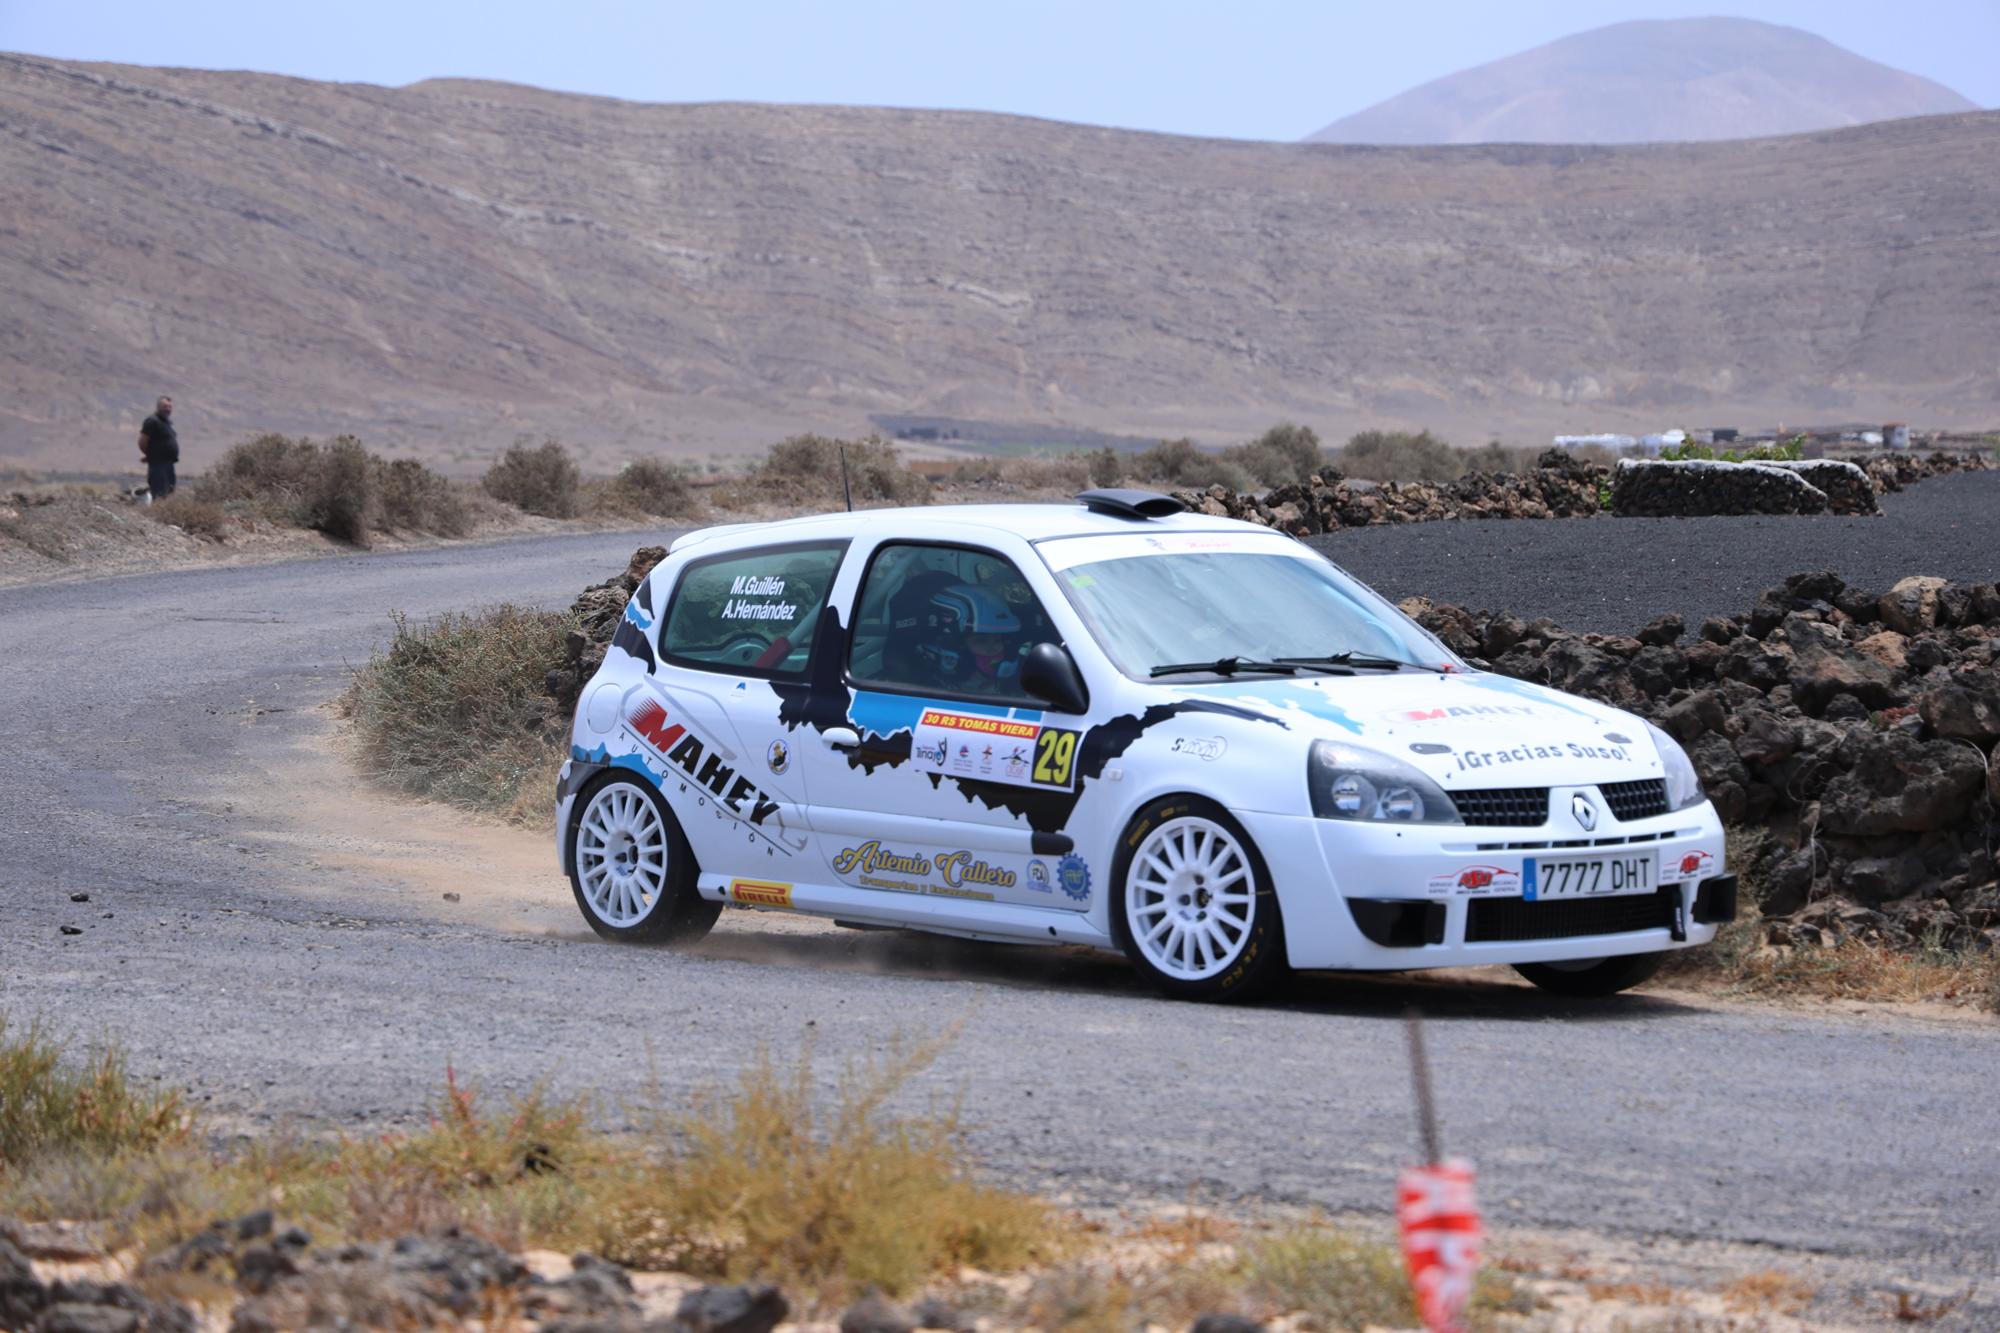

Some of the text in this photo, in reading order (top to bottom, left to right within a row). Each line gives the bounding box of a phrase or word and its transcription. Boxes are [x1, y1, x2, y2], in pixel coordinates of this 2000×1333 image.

[730, 575, 785, 596] M.Guillén
[721, 599, 797, 620] A.Hernández
[924, 713, 939, 724] 30
[940, 716, 957, 727] RS
[999, 723, 1035, 738] VIERA
[628, 697, 781, 826] MAHEY
[1033, 729, 1076, 785] 29
[1453, 742, 1632, 771] ¡Gracias Suso!
[833, 840, 1017, 888] Artemio Callero
[1541, 861, 1604, 894] 7777
[1611, 857, 1650, 890] DHT
[734, 883, 788, 905] PIRELLI
